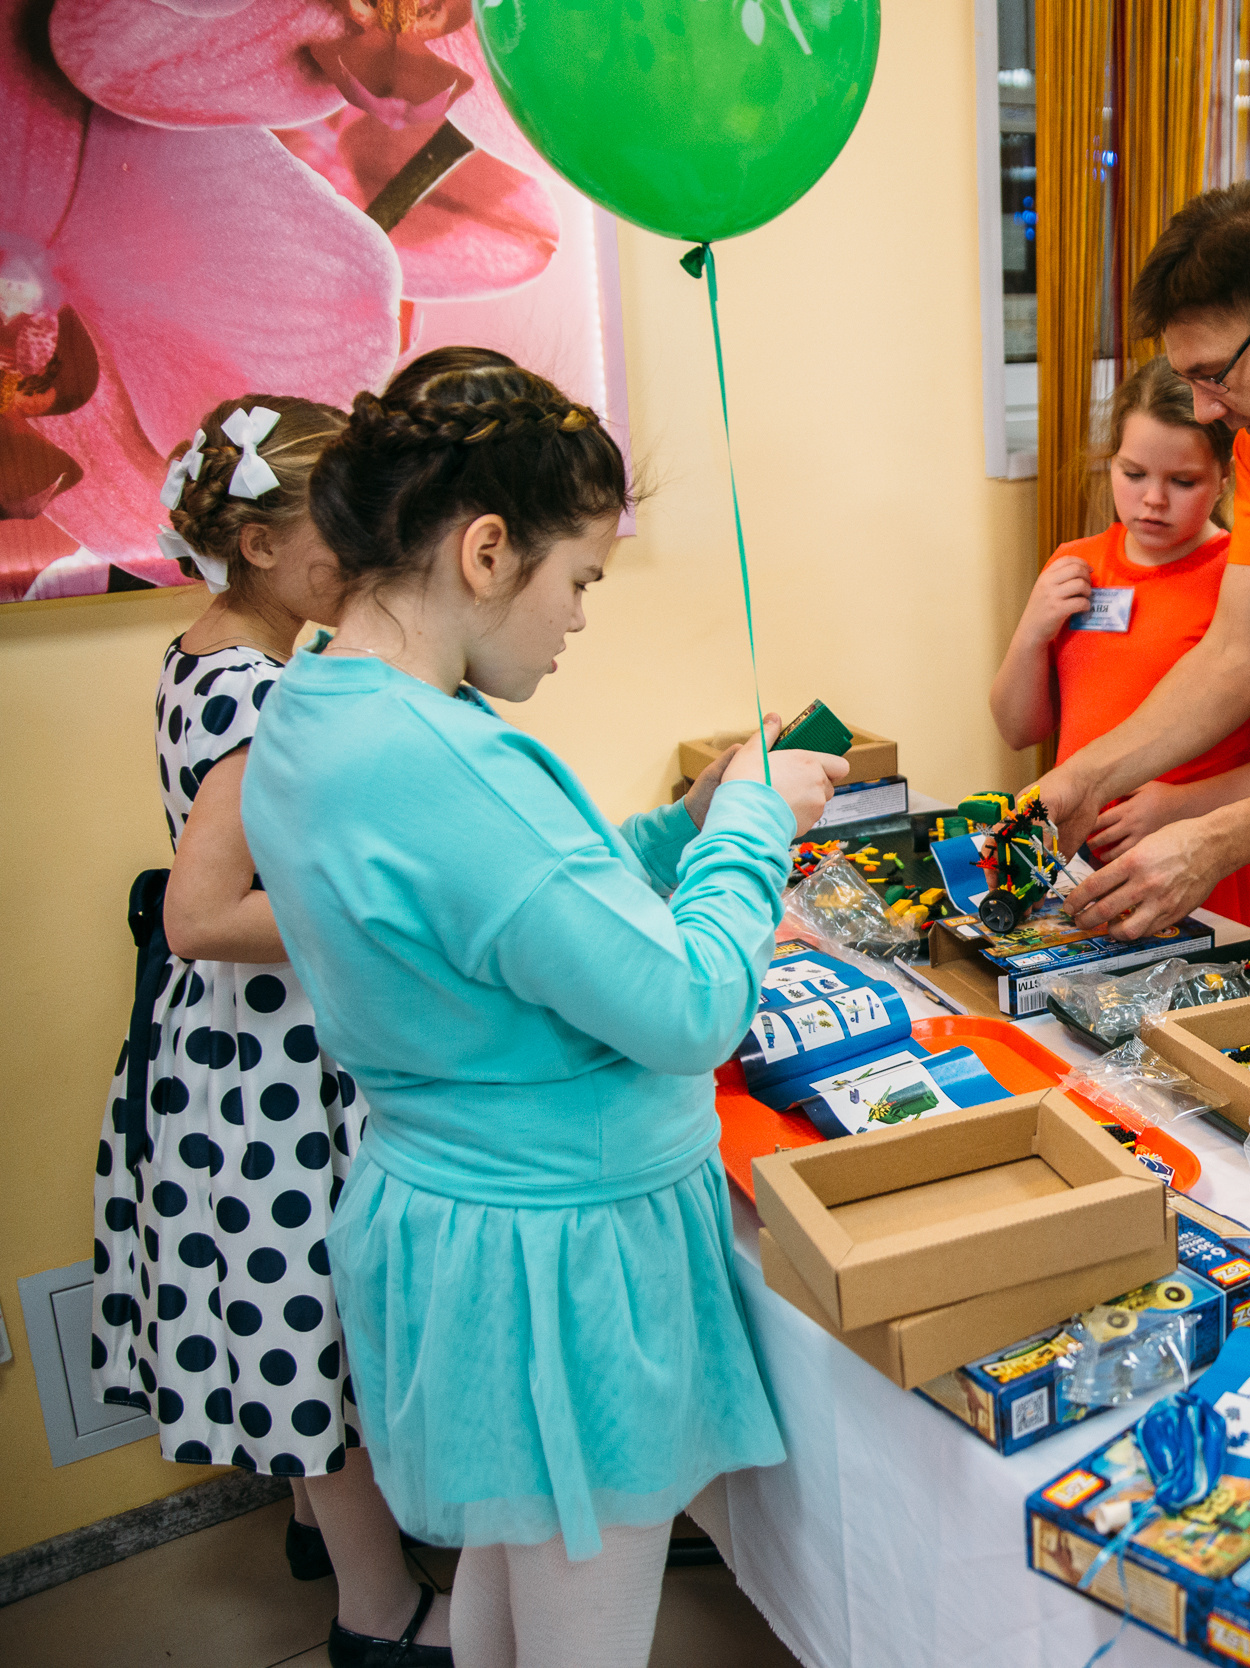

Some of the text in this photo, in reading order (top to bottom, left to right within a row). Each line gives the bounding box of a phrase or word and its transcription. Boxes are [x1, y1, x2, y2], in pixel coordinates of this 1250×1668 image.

[1185, 1240, 1215, 1258] 3017
[1201, 1246, 1228, 1261] 6+
[1211, 1262, 1250, 1281] LOZ
